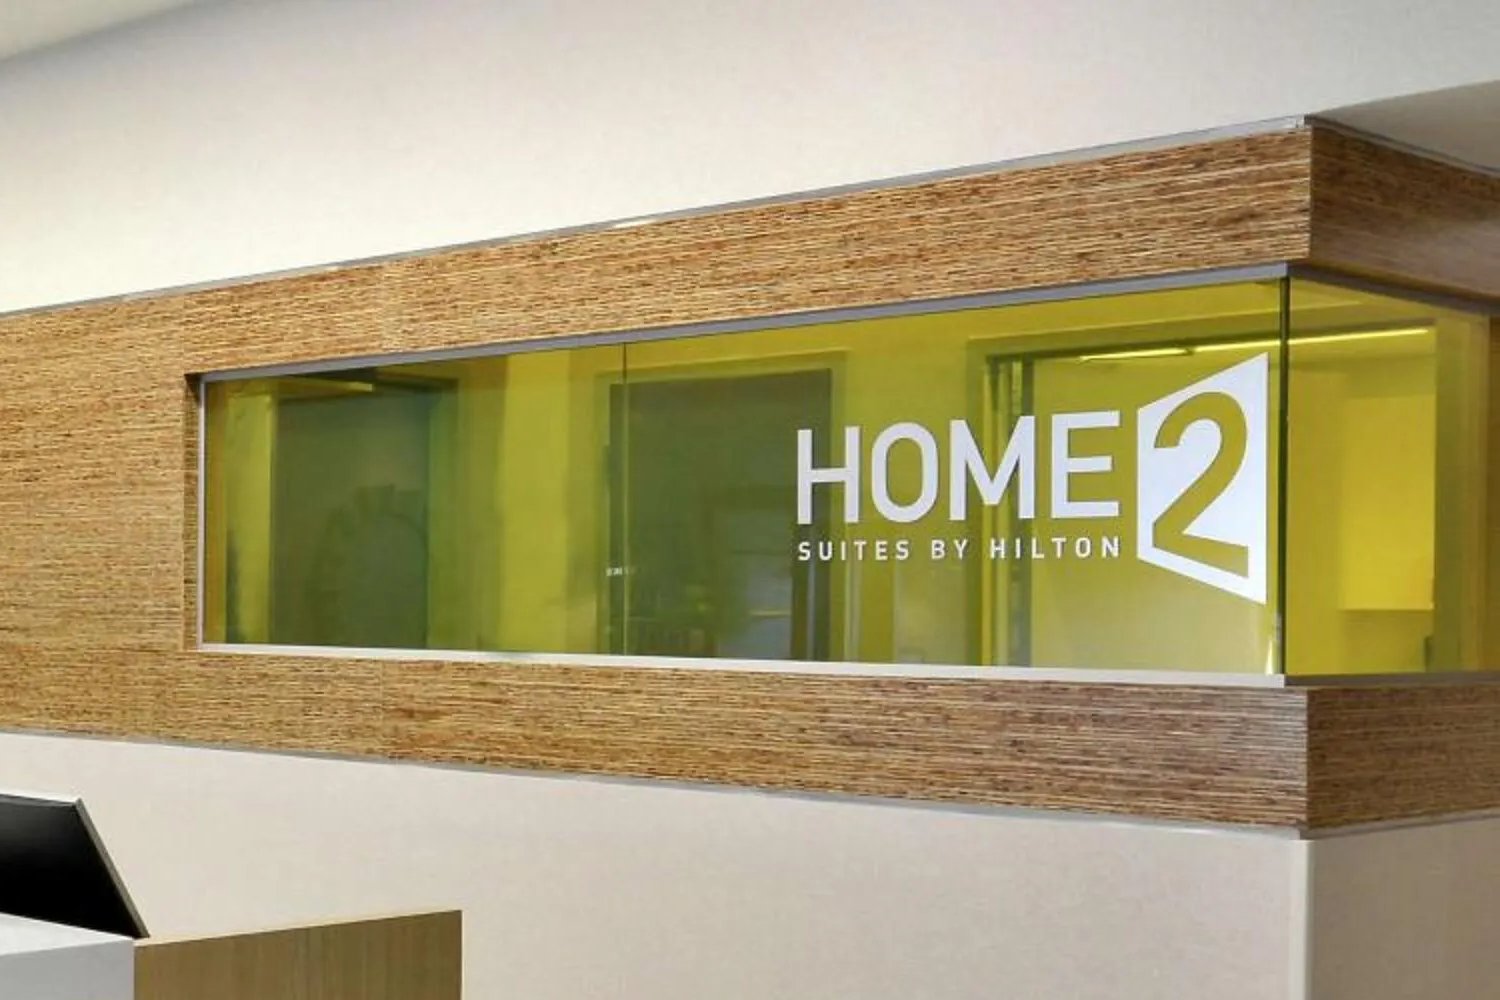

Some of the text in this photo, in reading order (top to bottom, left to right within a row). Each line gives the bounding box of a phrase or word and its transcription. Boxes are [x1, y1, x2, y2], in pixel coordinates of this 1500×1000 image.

[797, 536, 1121, 562] SUITES BY HILTON
